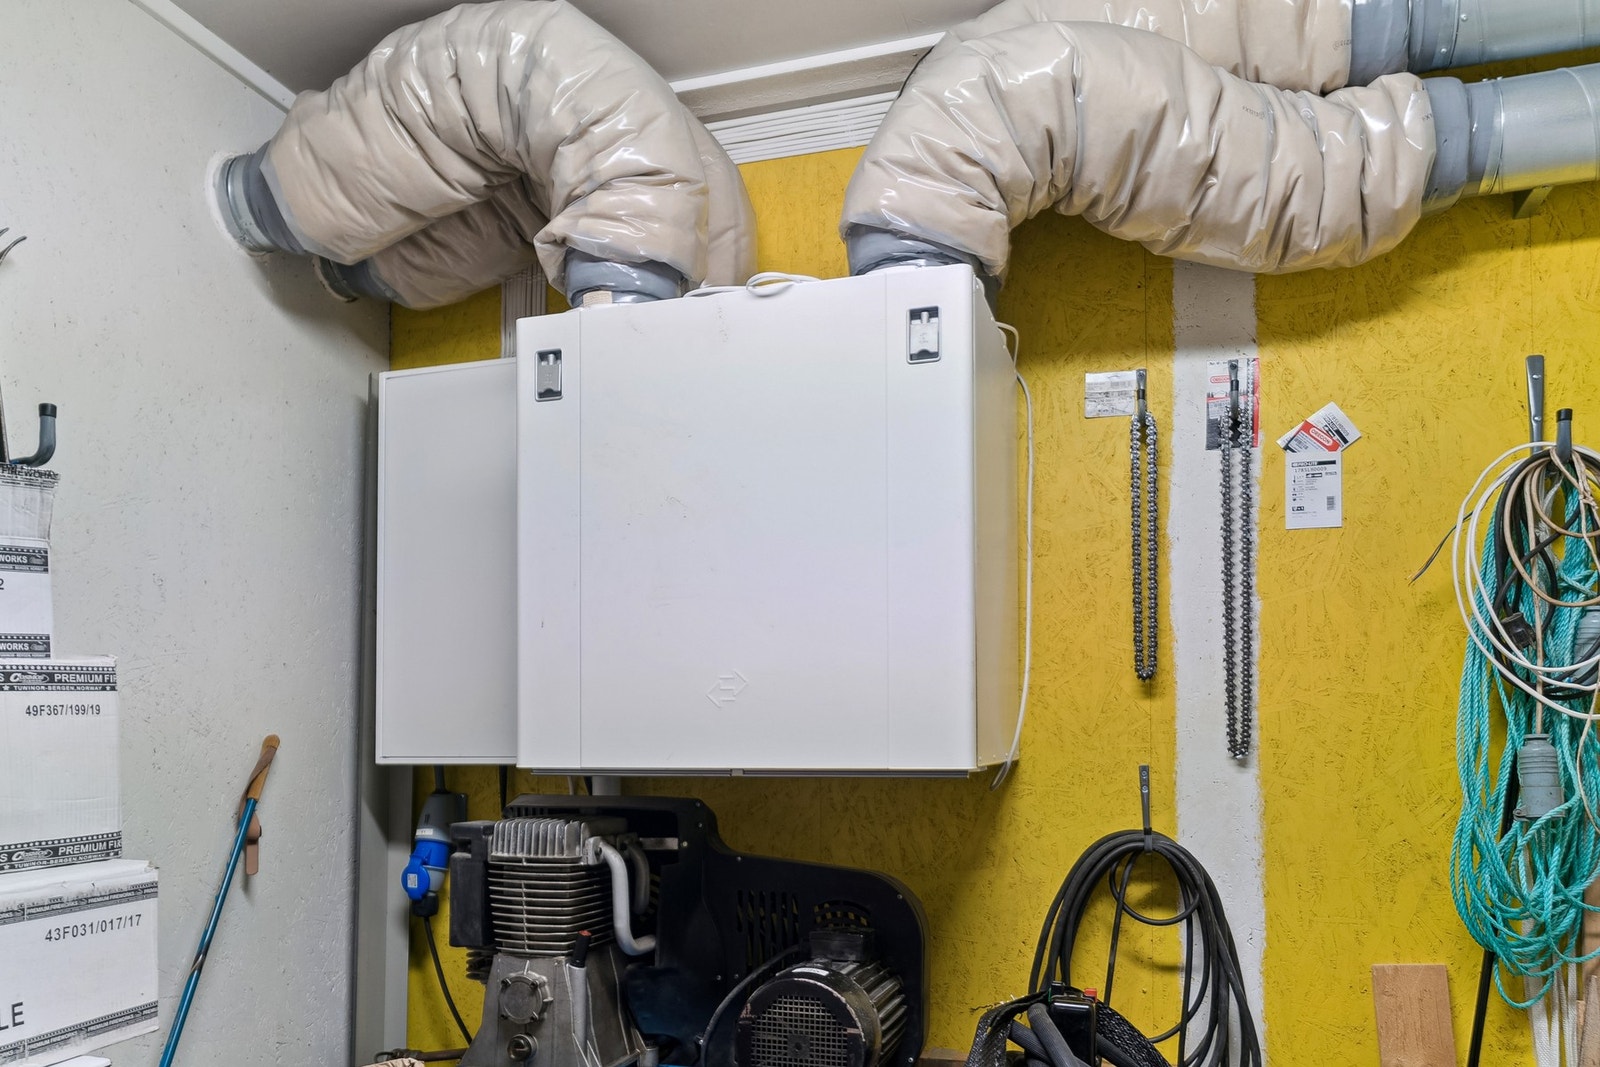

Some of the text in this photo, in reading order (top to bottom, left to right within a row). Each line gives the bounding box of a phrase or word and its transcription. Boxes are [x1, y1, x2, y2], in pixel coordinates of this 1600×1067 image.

[54, 673, 103, 683] PREMIUM
[25, 704, 101, 717] 49F367/199/19
[58, 842, 107, 855] PREMIUM
[45, 913, 142, 942] 43F031/017/17
